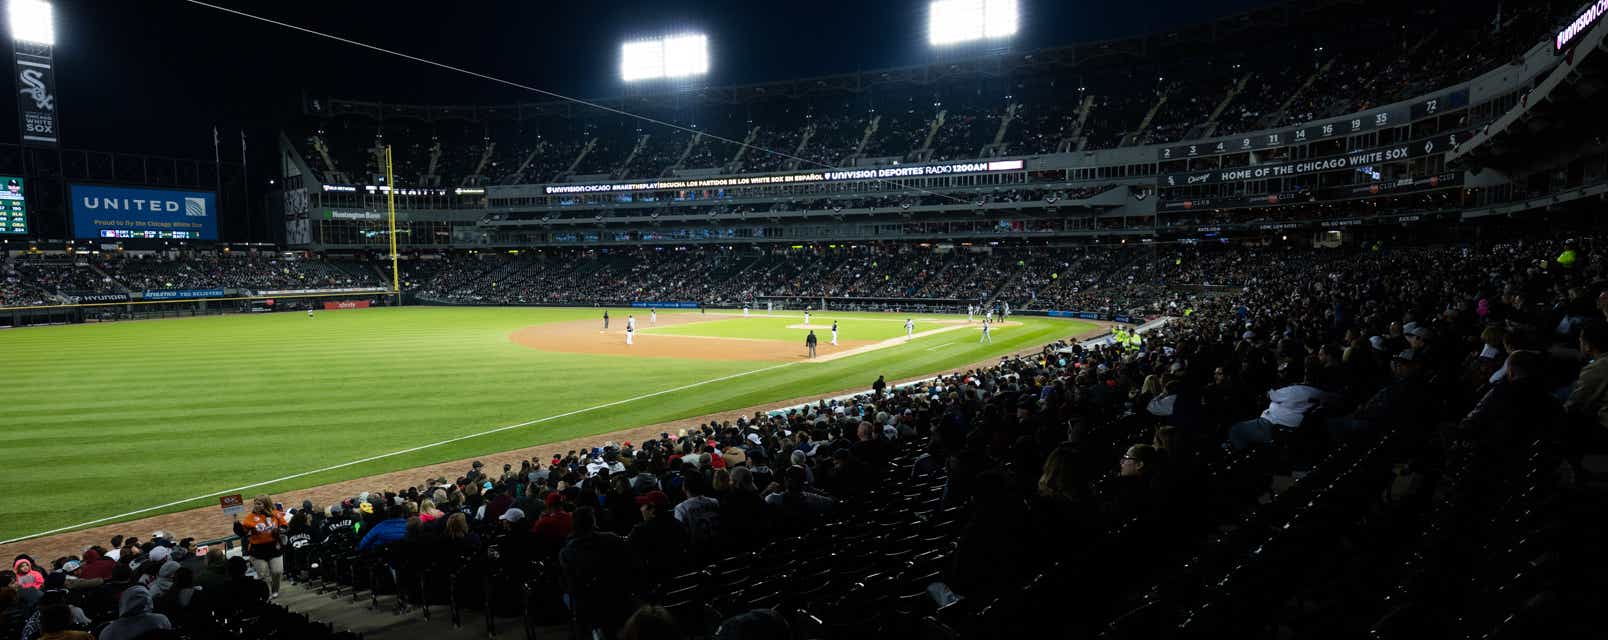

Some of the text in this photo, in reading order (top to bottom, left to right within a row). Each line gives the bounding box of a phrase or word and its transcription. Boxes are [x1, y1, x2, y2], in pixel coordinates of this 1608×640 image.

[1425, 100, 1437, 111] 72
[1375, 113, 1387, 122] 35
[1351, 119, 1361, 128] 19
[26, 124, 53, 134] SOX
[1323, 125, 1333, 134] 16
[1269, 134, 1278, 142] 11
[1295, 130, 1306, 138] 14
[1243, 138, 1250, 146] 9
[1222, 169, 1251, 181] HOME
[1254, 167, 1271, 177] OF
[1273, 164, 1295, 175] THE
[1296, 157, 1346, 173] CHICAGO
[1350, 150, 1382, 167] WHITE
[1385, 147, 1409, 161] SOX
[832, 163, 988, 180] UNIVISION DEPORTES RADIO 1200AM
[699, 179, 728, 187] PARTIDOS
[552, 185, 585, 193] UNIVISION
[84, 197, 179, 212] UNITED
